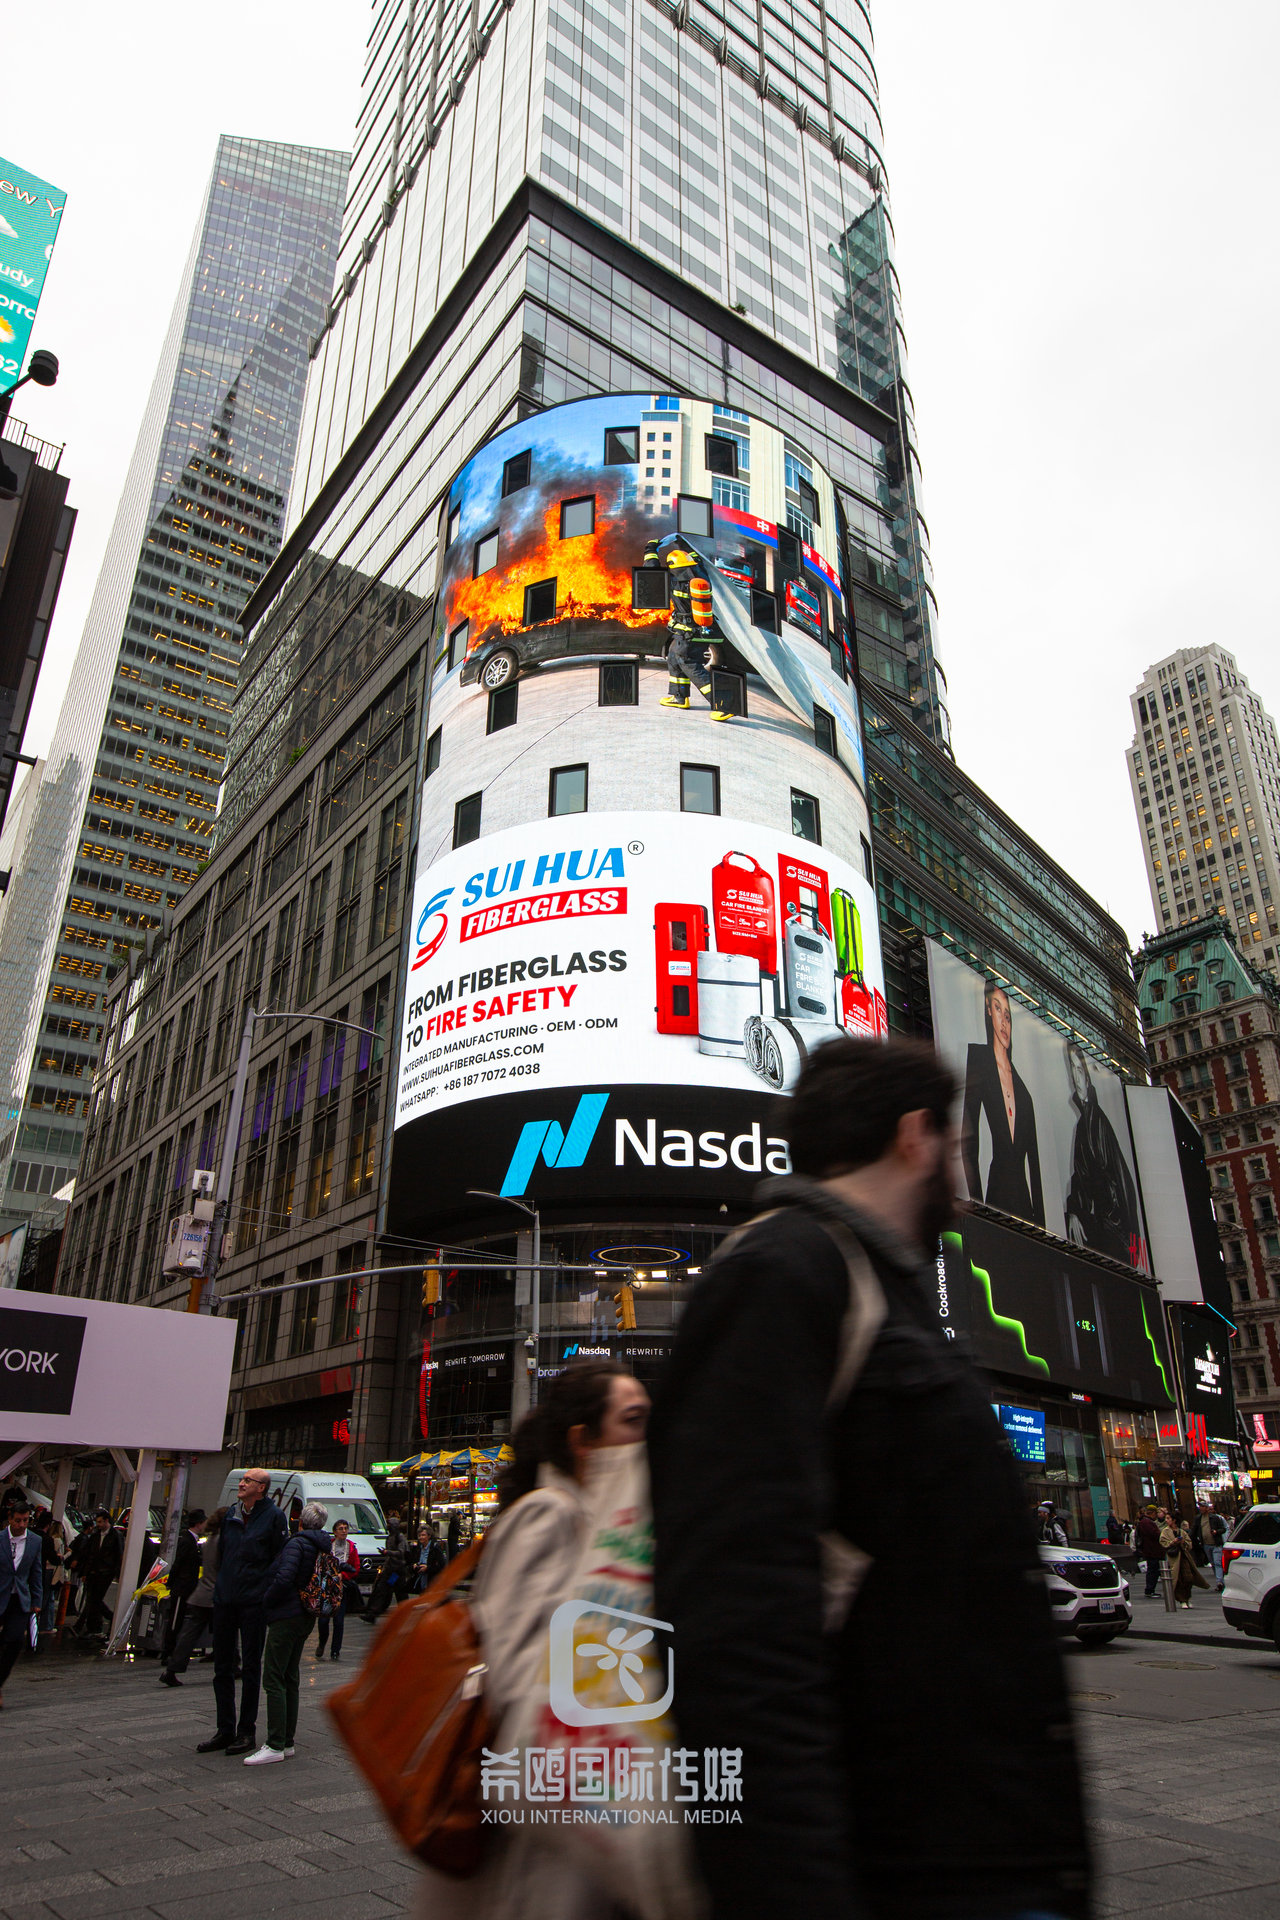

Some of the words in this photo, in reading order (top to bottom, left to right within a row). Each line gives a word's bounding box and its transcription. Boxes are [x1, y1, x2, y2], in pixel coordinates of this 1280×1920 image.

[0, 180, 38, 206] ew
[0, 263, 34, 288] udy
[0, 294, 36, 321] orro
[462, 859, 526, 907] SUI
[532, 847, 625, 887] HUA
[465, 890, 619, 938] FIBERGLASS
[408, 980, 453, 1024] FROM
[458, 949, 627, 997] FIBERGLASS
[406, 1024, 424, 1053] TO
[427, 1004, 467, 1040] FIRE
[472, 984, 578, 1023] SAFETY
[401, 1043, 544, 1094] WWW.SUIHUAFIBERGLASS.COM
[402, 1047, 443, 1076] INTEGRATED
[443, 1024, 538, 1055] MANUFACTURING
[546, 1020, 576, 1033] OEM
[585, 1018, 618, 1029] ODM
[399, 1086, 439, 1113] WHATSAPP:
[443, 1078, 461, 1091] +86
[463, 1074, 480, 1088] 187
[480, 1068, 507, 1083] 7072
[509, 1063, 541, 1078] 4038
[615, 1118, 792, 1175] Nasda
[935, 1254, 949, 1318] Cockroach
[445, 1357, 467, 1366] REWRITE
[469, 1353, 506, 1363] TOMORROW
[578, 1346, 611, 1357] Nasdaq
[626, 1348, 663, 1356] REWRITE
